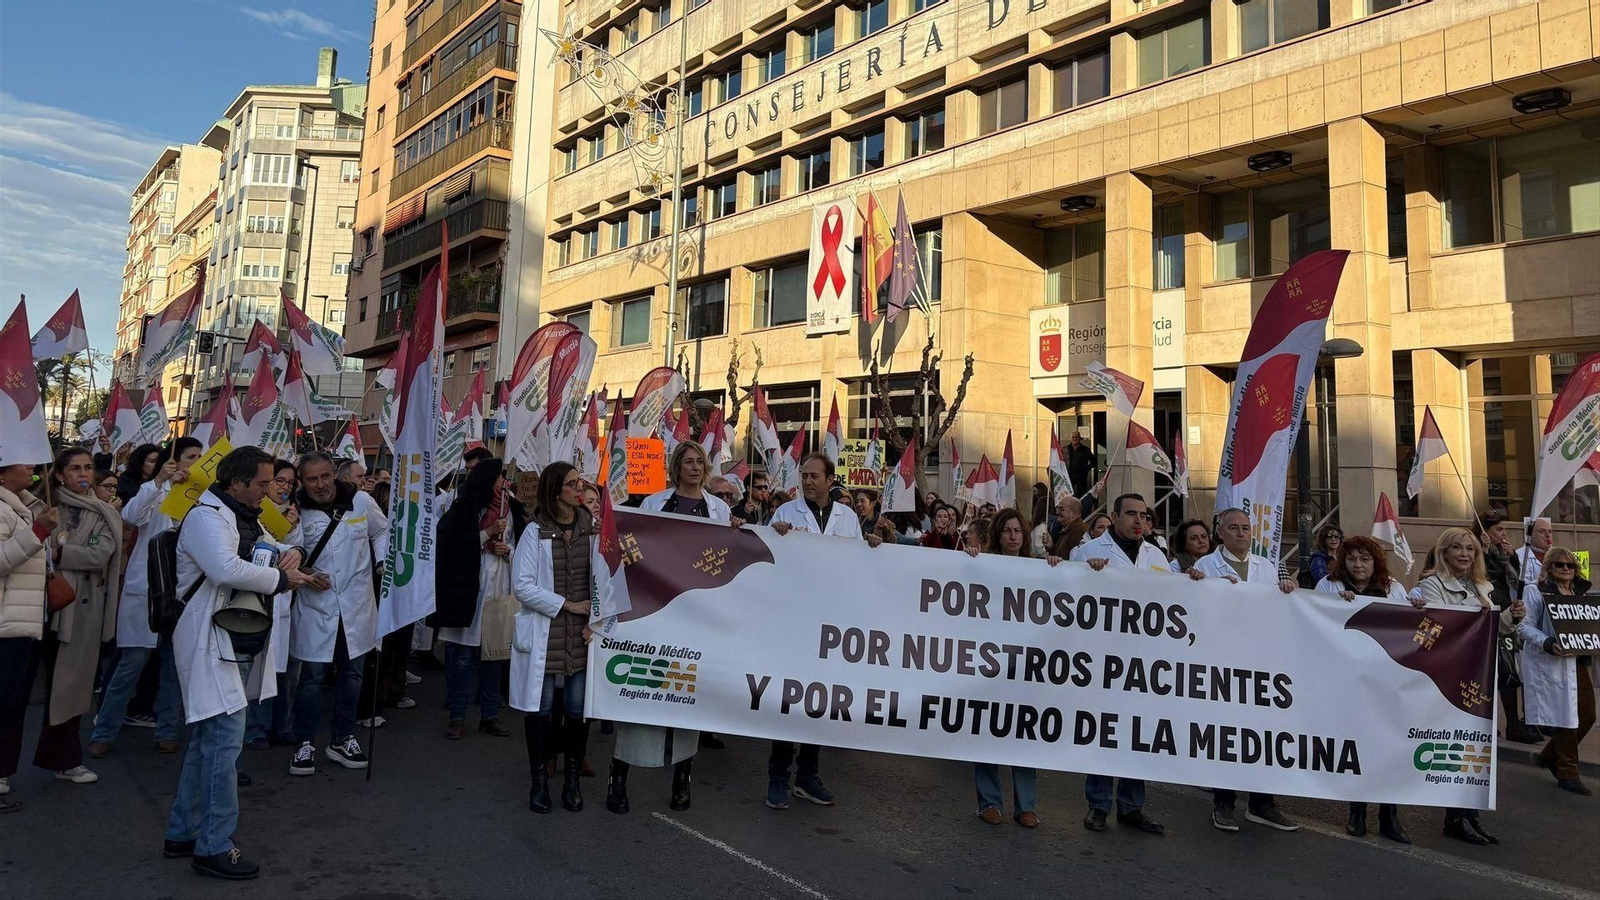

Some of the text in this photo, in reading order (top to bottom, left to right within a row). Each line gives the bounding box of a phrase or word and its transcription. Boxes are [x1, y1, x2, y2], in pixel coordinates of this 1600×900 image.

[704, 20, 944, 148] CONSEJERÍA
[1068, 324, 1106, 342] Región
[1068, 340, 1106, 356] Conseje
[1154, 332, 1172, 347] lud
[559, 338, 579, 360] Murcia
[513, 378, 537, 408] Sindicato
[1547, 420, 1578, 455] Sindicato
[418, 450, 435, 561] Región de Murcia
[1271, 504, 1284, 542] Murcia
[920, 579, 1196, 647] POR NOSOTROS,
[600, 637, 702, 661] Sindicato Médico
[605, 653, 698, 693] CESM
[819, 624, 1293, 710] POR NUESTROS PACIENTES
[619, 687, 696, 705] Región de Murcia
[746, 674, 1362, 776] Y POR EL FUTURO DE LA MEDICINA
[1407, 727, 1451, 741] Sindicato
[1425, 773, 1490, 787] Región de Murc
